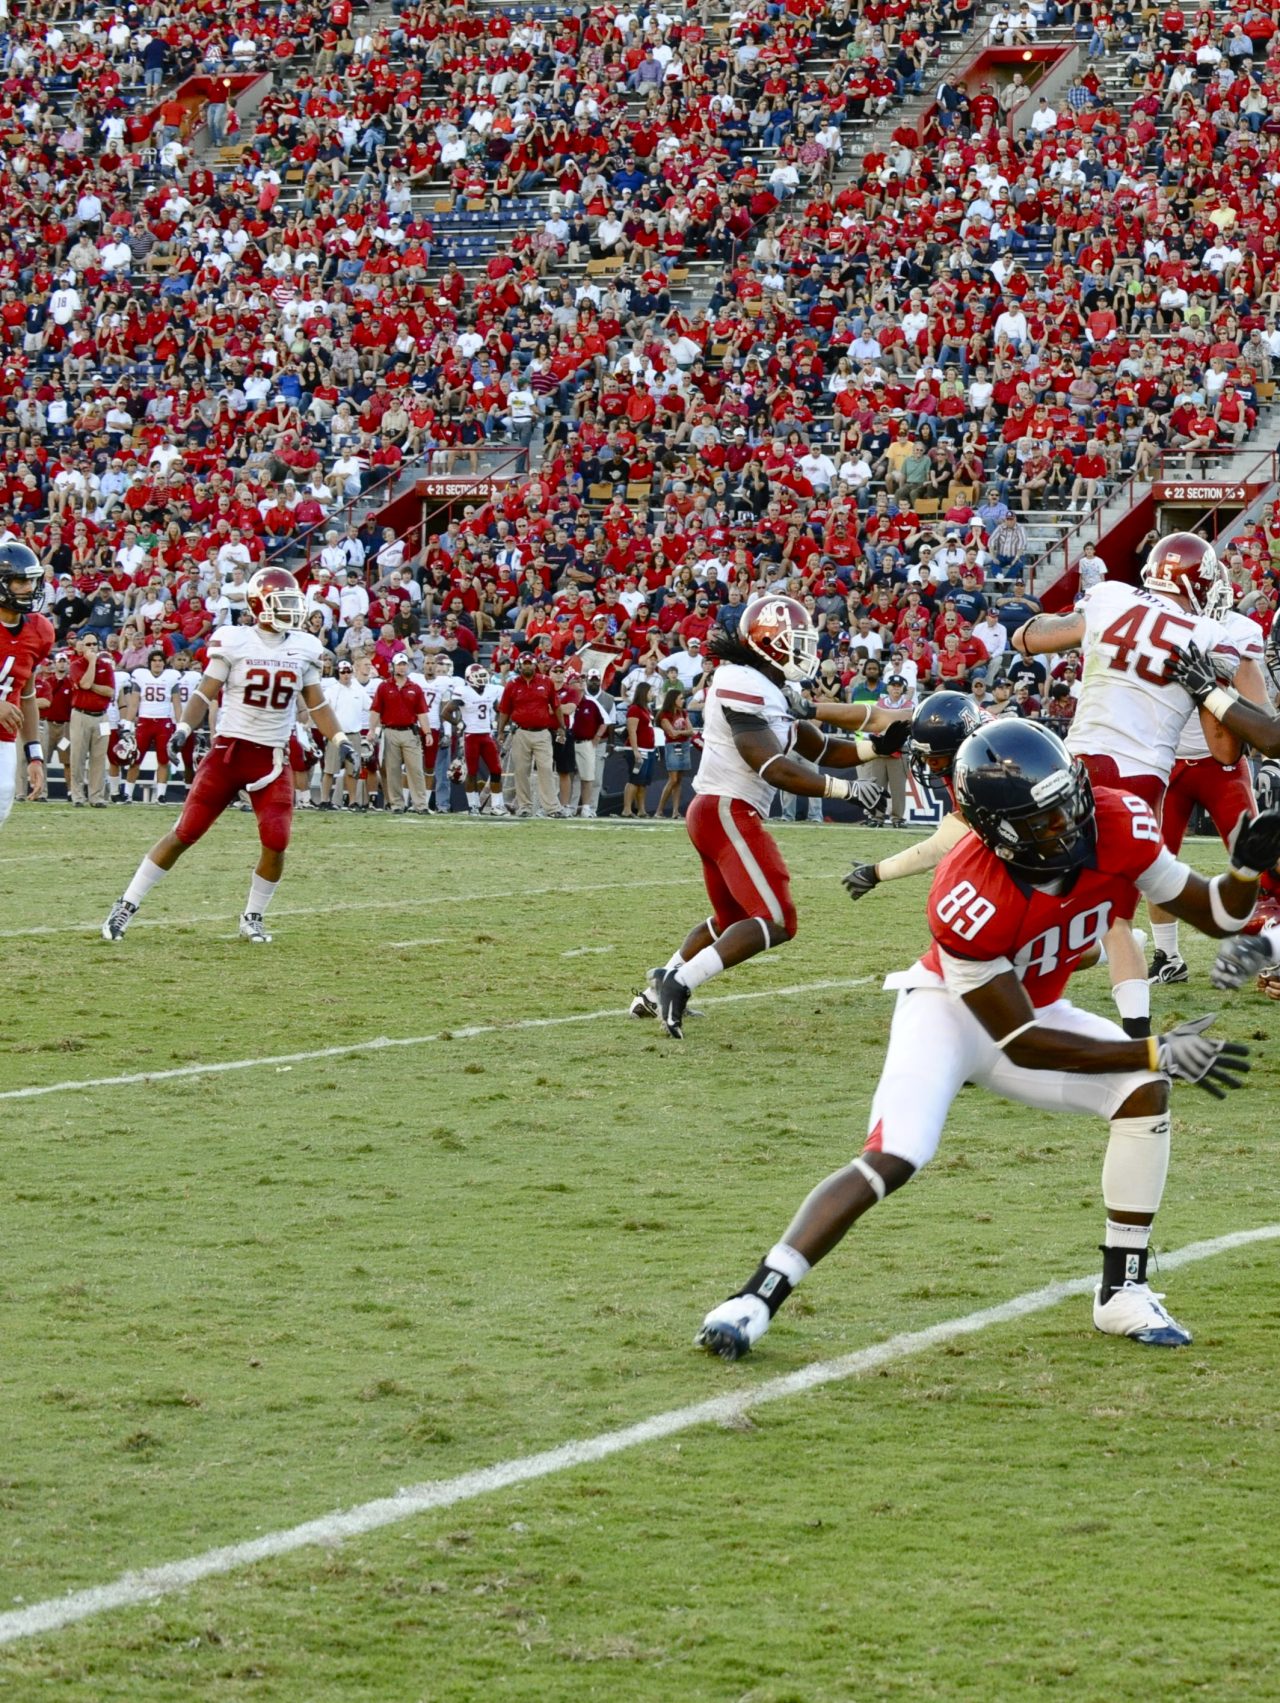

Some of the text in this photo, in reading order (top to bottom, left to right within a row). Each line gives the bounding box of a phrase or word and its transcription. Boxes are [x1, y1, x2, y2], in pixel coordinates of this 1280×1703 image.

[435, 484, 489, 495] 21 SECTION 22
[1173, 487, 1185, 499] 22
[1187, 487, 1222, 499] SECTION
[1101, 604, 1196, 687] 45
[145, 686, 166, 702] 85
[242, 668, 297, 710] 26
[478, 704, 487, 720] 3
[936, 880, 997, 942] 89
[1013, 900, 1114, 983] 89
